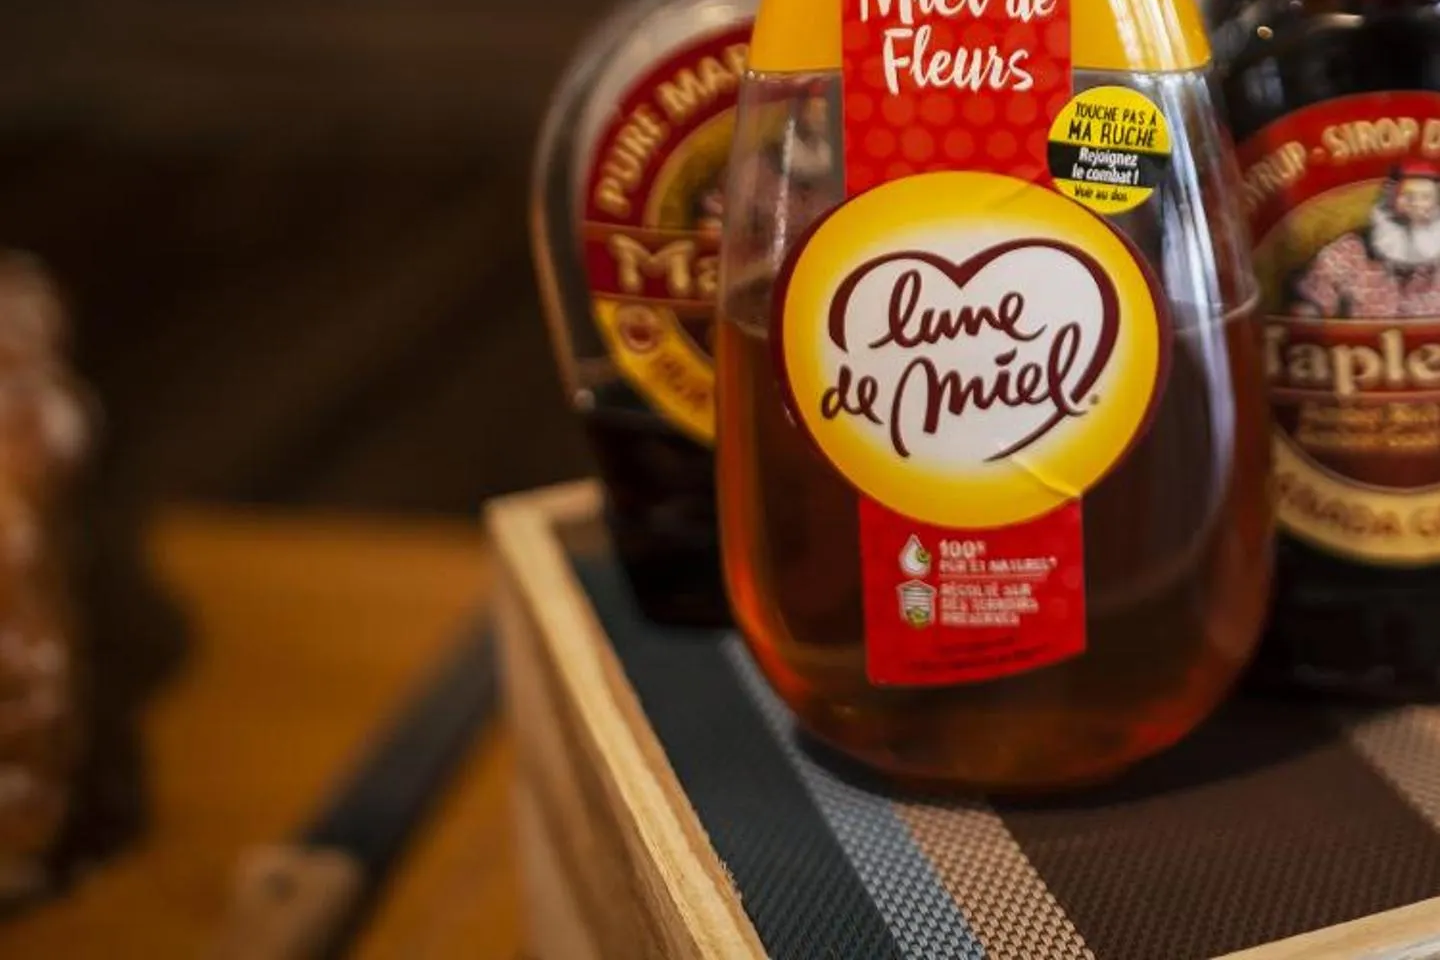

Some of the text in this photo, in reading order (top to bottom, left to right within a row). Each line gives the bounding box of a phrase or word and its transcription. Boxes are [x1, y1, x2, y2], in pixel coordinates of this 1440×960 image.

[884, 29, 1034, 95] Fleurs
[596, 43, 750, 217] PURE MAP
[1075, 102, 1119, 121] TOUCHE
[1122, 109, 1146, 125] PAS
[1068, 119, 1157, 147] MA RUCHE
[1321, 117, 1419, 166] SIROP
[1072, 163, 1085, 179] le
[1086, 165, 1132, 185] combat
[1079, 147, 1138, 167] Rejoignez
[821, 365, 883, 425] de
